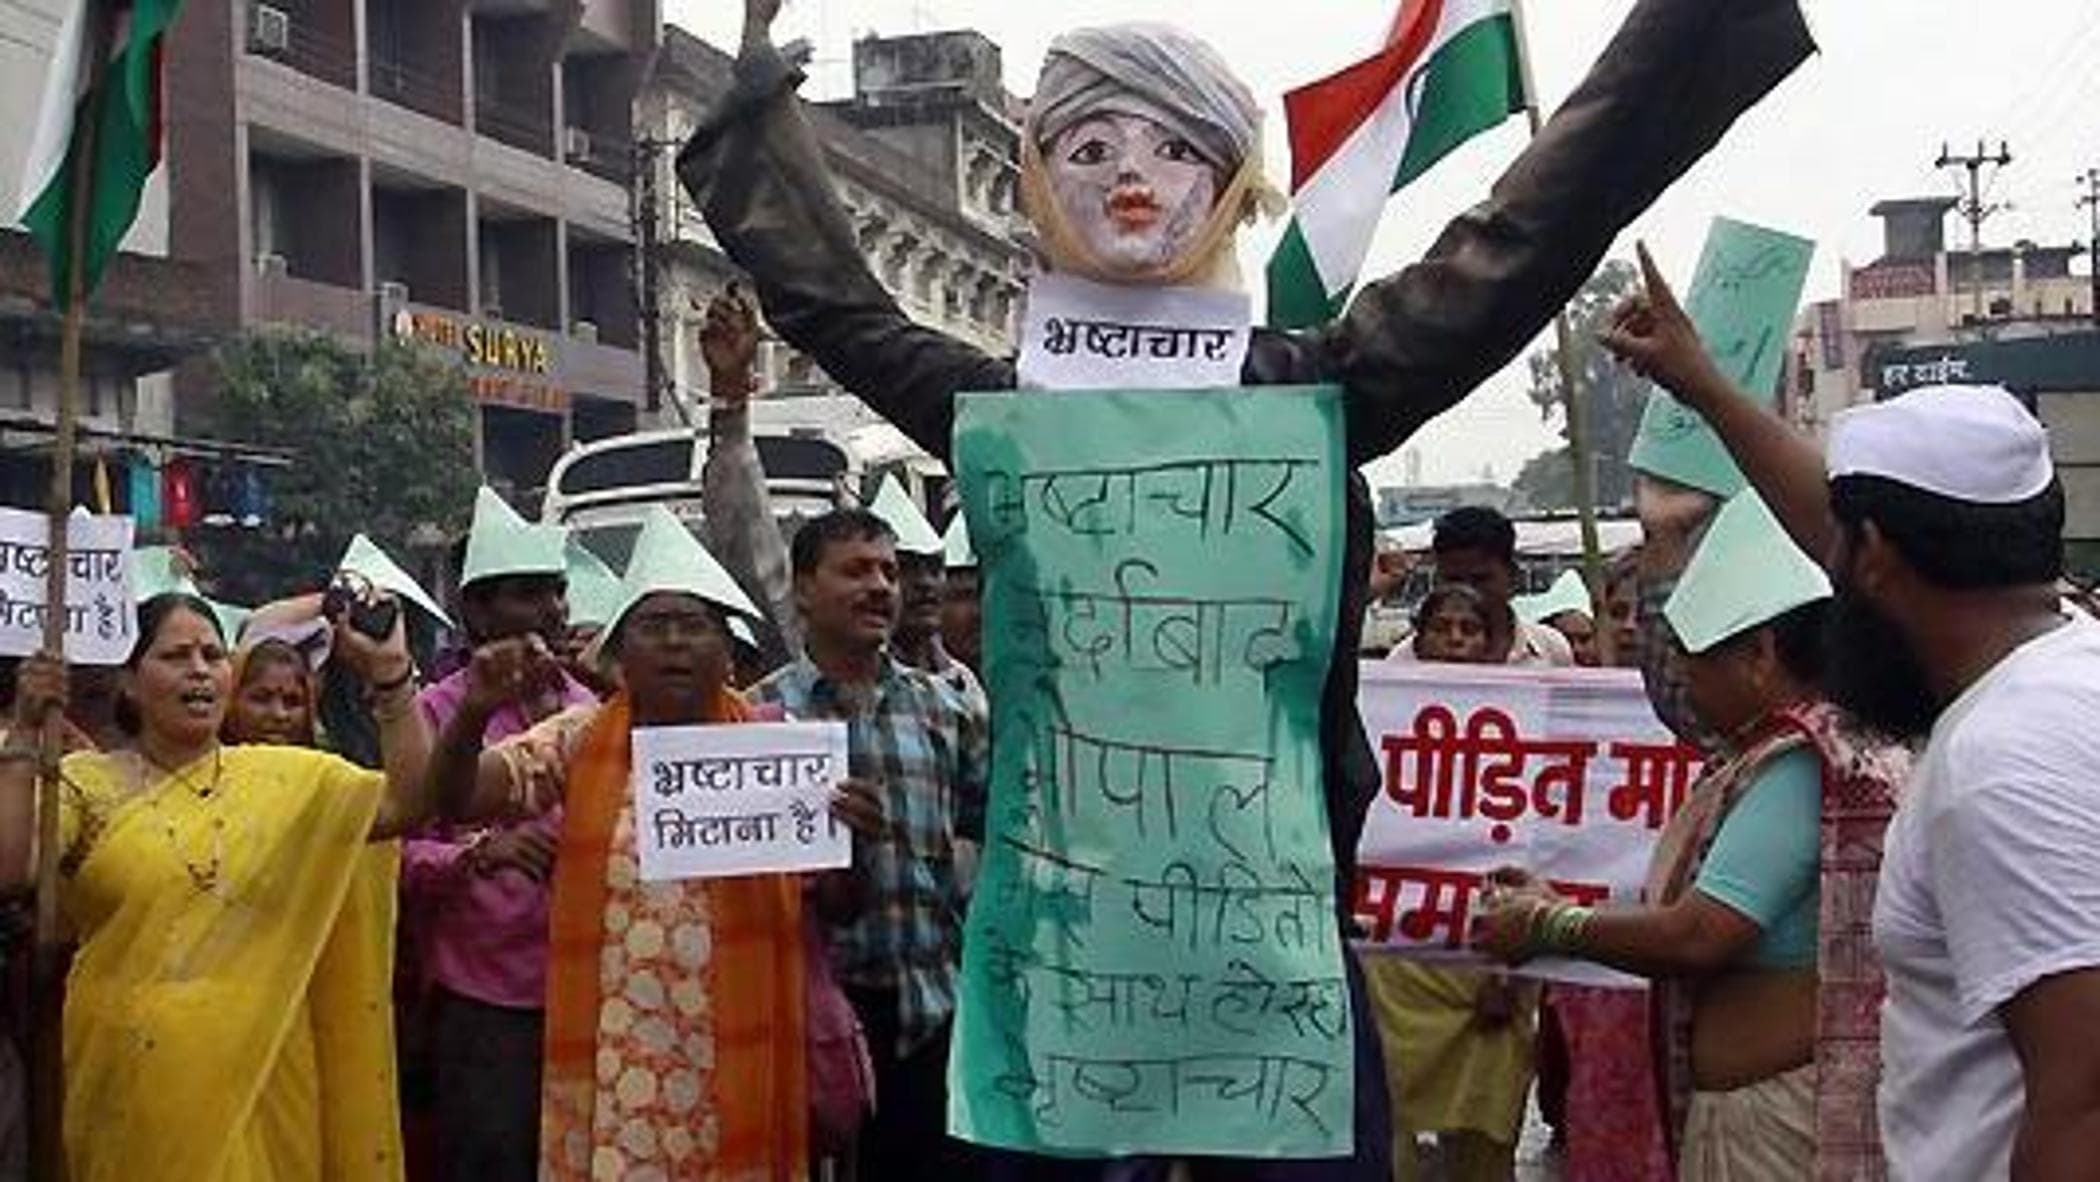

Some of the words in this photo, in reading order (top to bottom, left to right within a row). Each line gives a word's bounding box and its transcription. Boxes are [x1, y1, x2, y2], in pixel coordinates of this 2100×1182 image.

[466, 323, 549, 373] SURYA
[1043, 317, 1235, 360] भ्रष्टाचार
[654, 753, 832, 797] भ्रष्टाचार
[1382, 706, 1597, 843] पीड़ित
[654, 808, 783, 848] मिटाना
